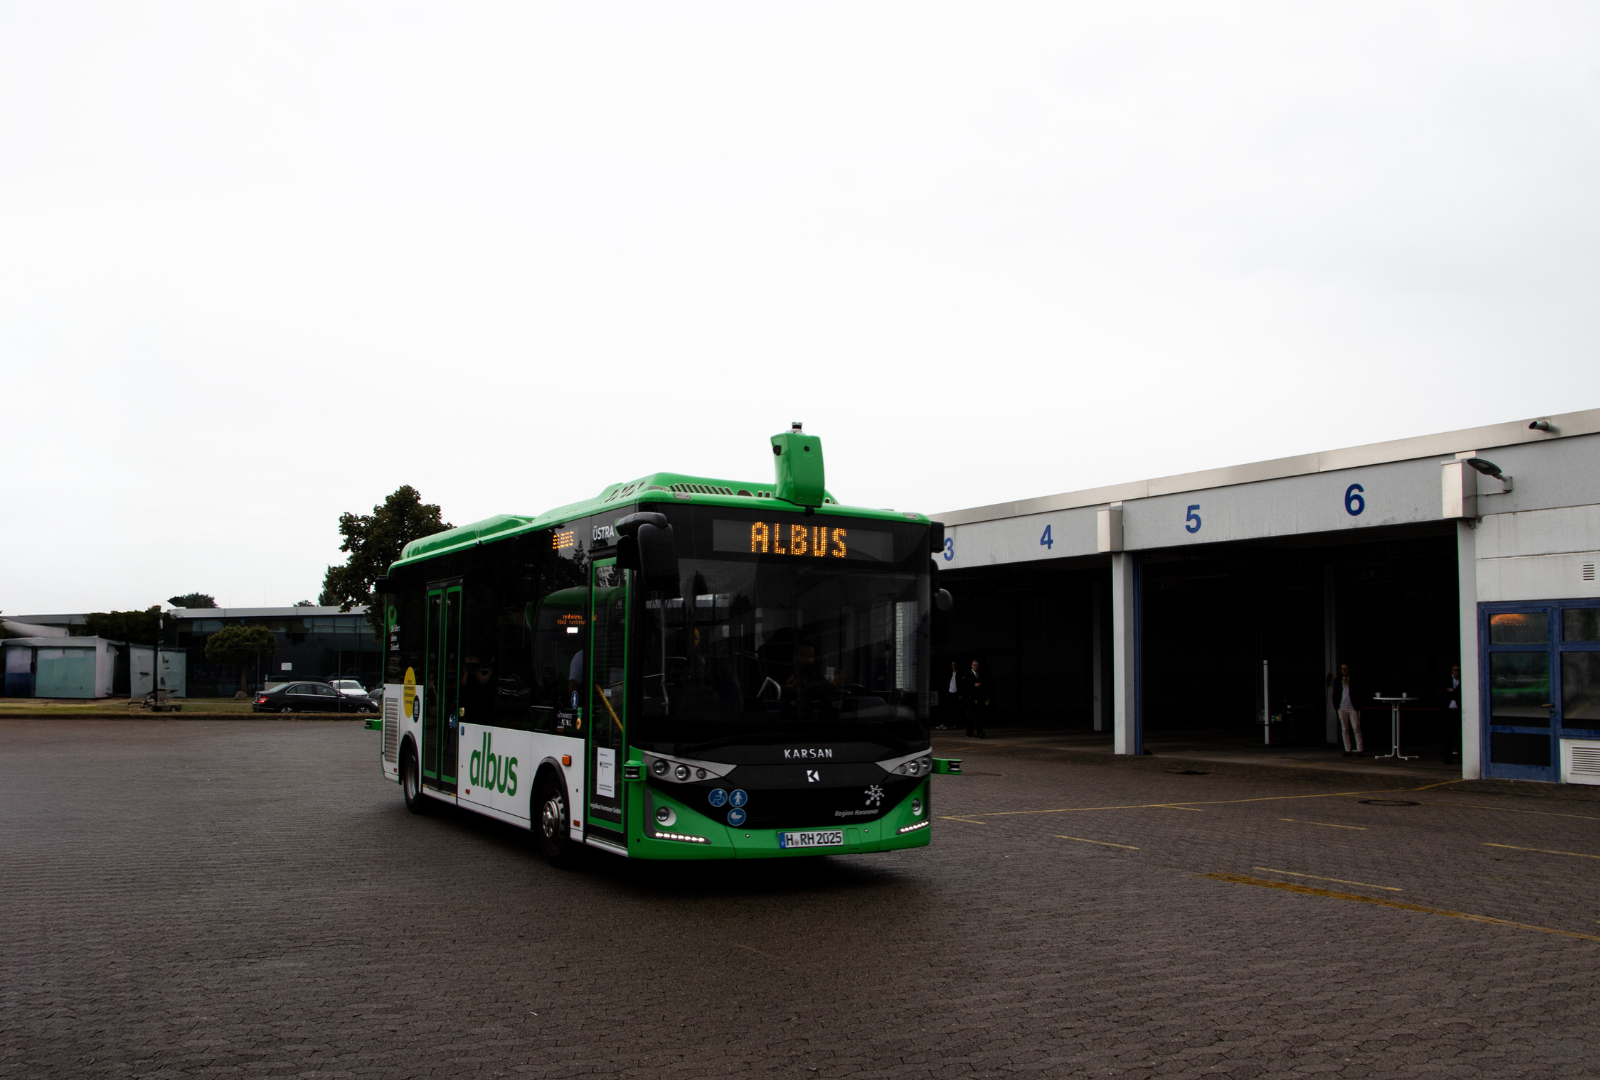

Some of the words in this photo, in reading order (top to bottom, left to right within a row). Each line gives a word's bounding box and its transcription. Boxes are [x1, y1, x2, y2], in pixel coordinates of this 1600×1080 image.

[1344, 483, 1365, 516] 6
[1185, 503, 1202, 533] 5
[592, 524, 615, 540] ÜSTRA
[750, 521, 847, 558] ALBUS
[1040, 524, 1054, 549] 4
[944, 537, 954, 561] 3
[470, 732, 518, 797] albus
[784, 748, 833, 759] KARSAN
[834, 810, 854, 818] Region
[855, 808, 880, 816] Hannover
[786, 834, 794, 846] H
[800, 833, 814, 845] RH
[816, 832, 842, 844] 2025
